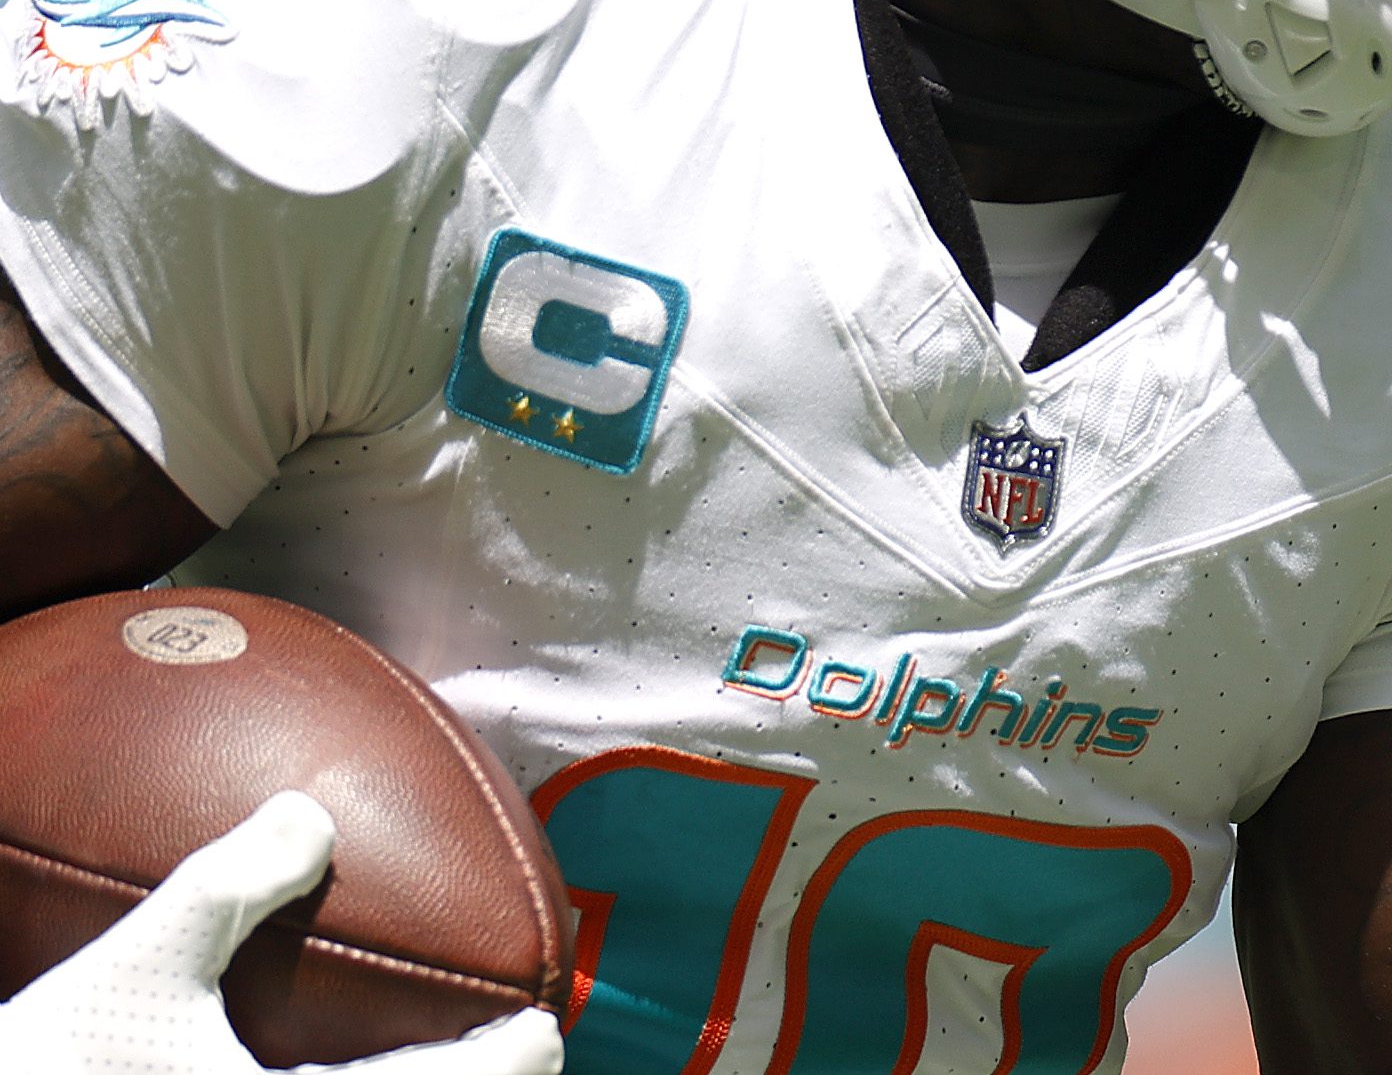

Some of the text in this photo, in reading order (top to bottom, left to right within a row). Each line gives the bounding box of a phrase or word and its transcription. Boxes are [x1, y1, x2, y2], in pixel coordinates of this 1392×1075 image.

[479, 250, 669, 415] C
[974, 470, 1045, 526] NFL
[147, 623, 208, 653] 023
[721, 623, 1165, 760] Dolphins
